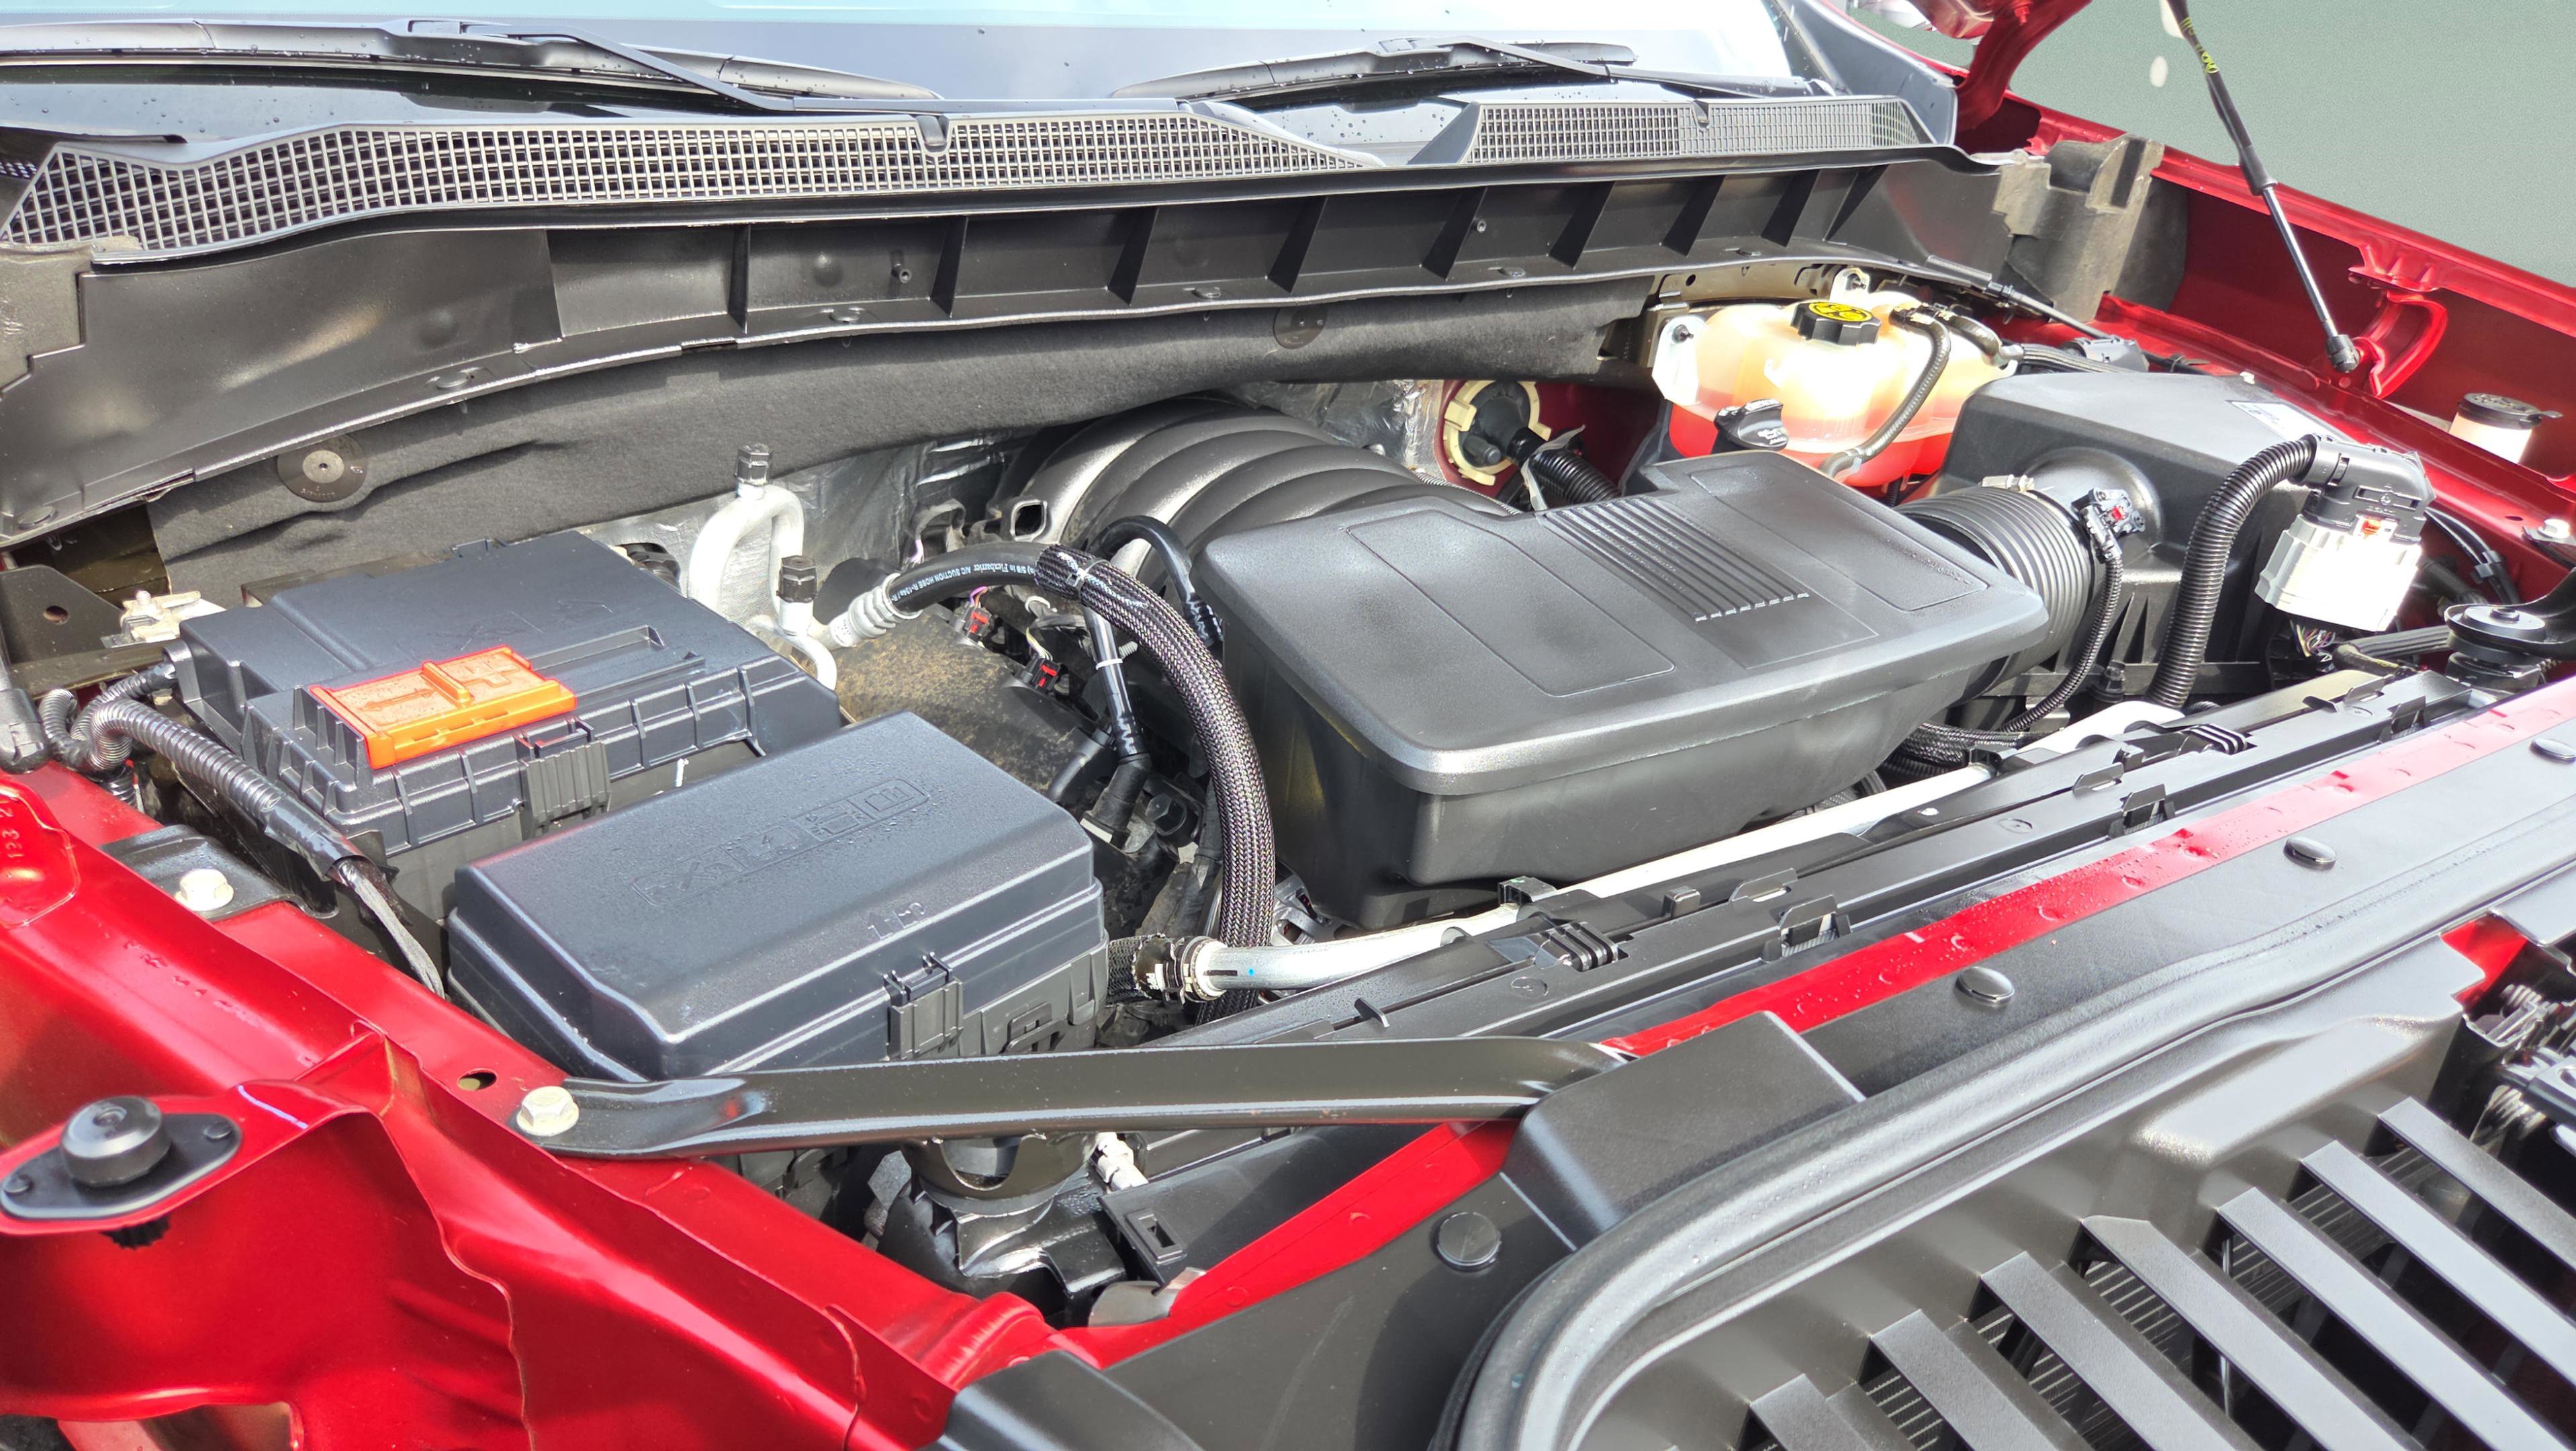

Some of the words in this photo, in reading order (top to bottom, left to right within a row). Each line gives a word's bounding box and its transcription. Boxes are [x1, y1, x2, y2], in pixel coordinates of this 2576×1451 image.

[934, 568, 961, 582] SUCTION
[960, 566, 971, 575] A/C
[917, 576, 935, 588] HOSE
